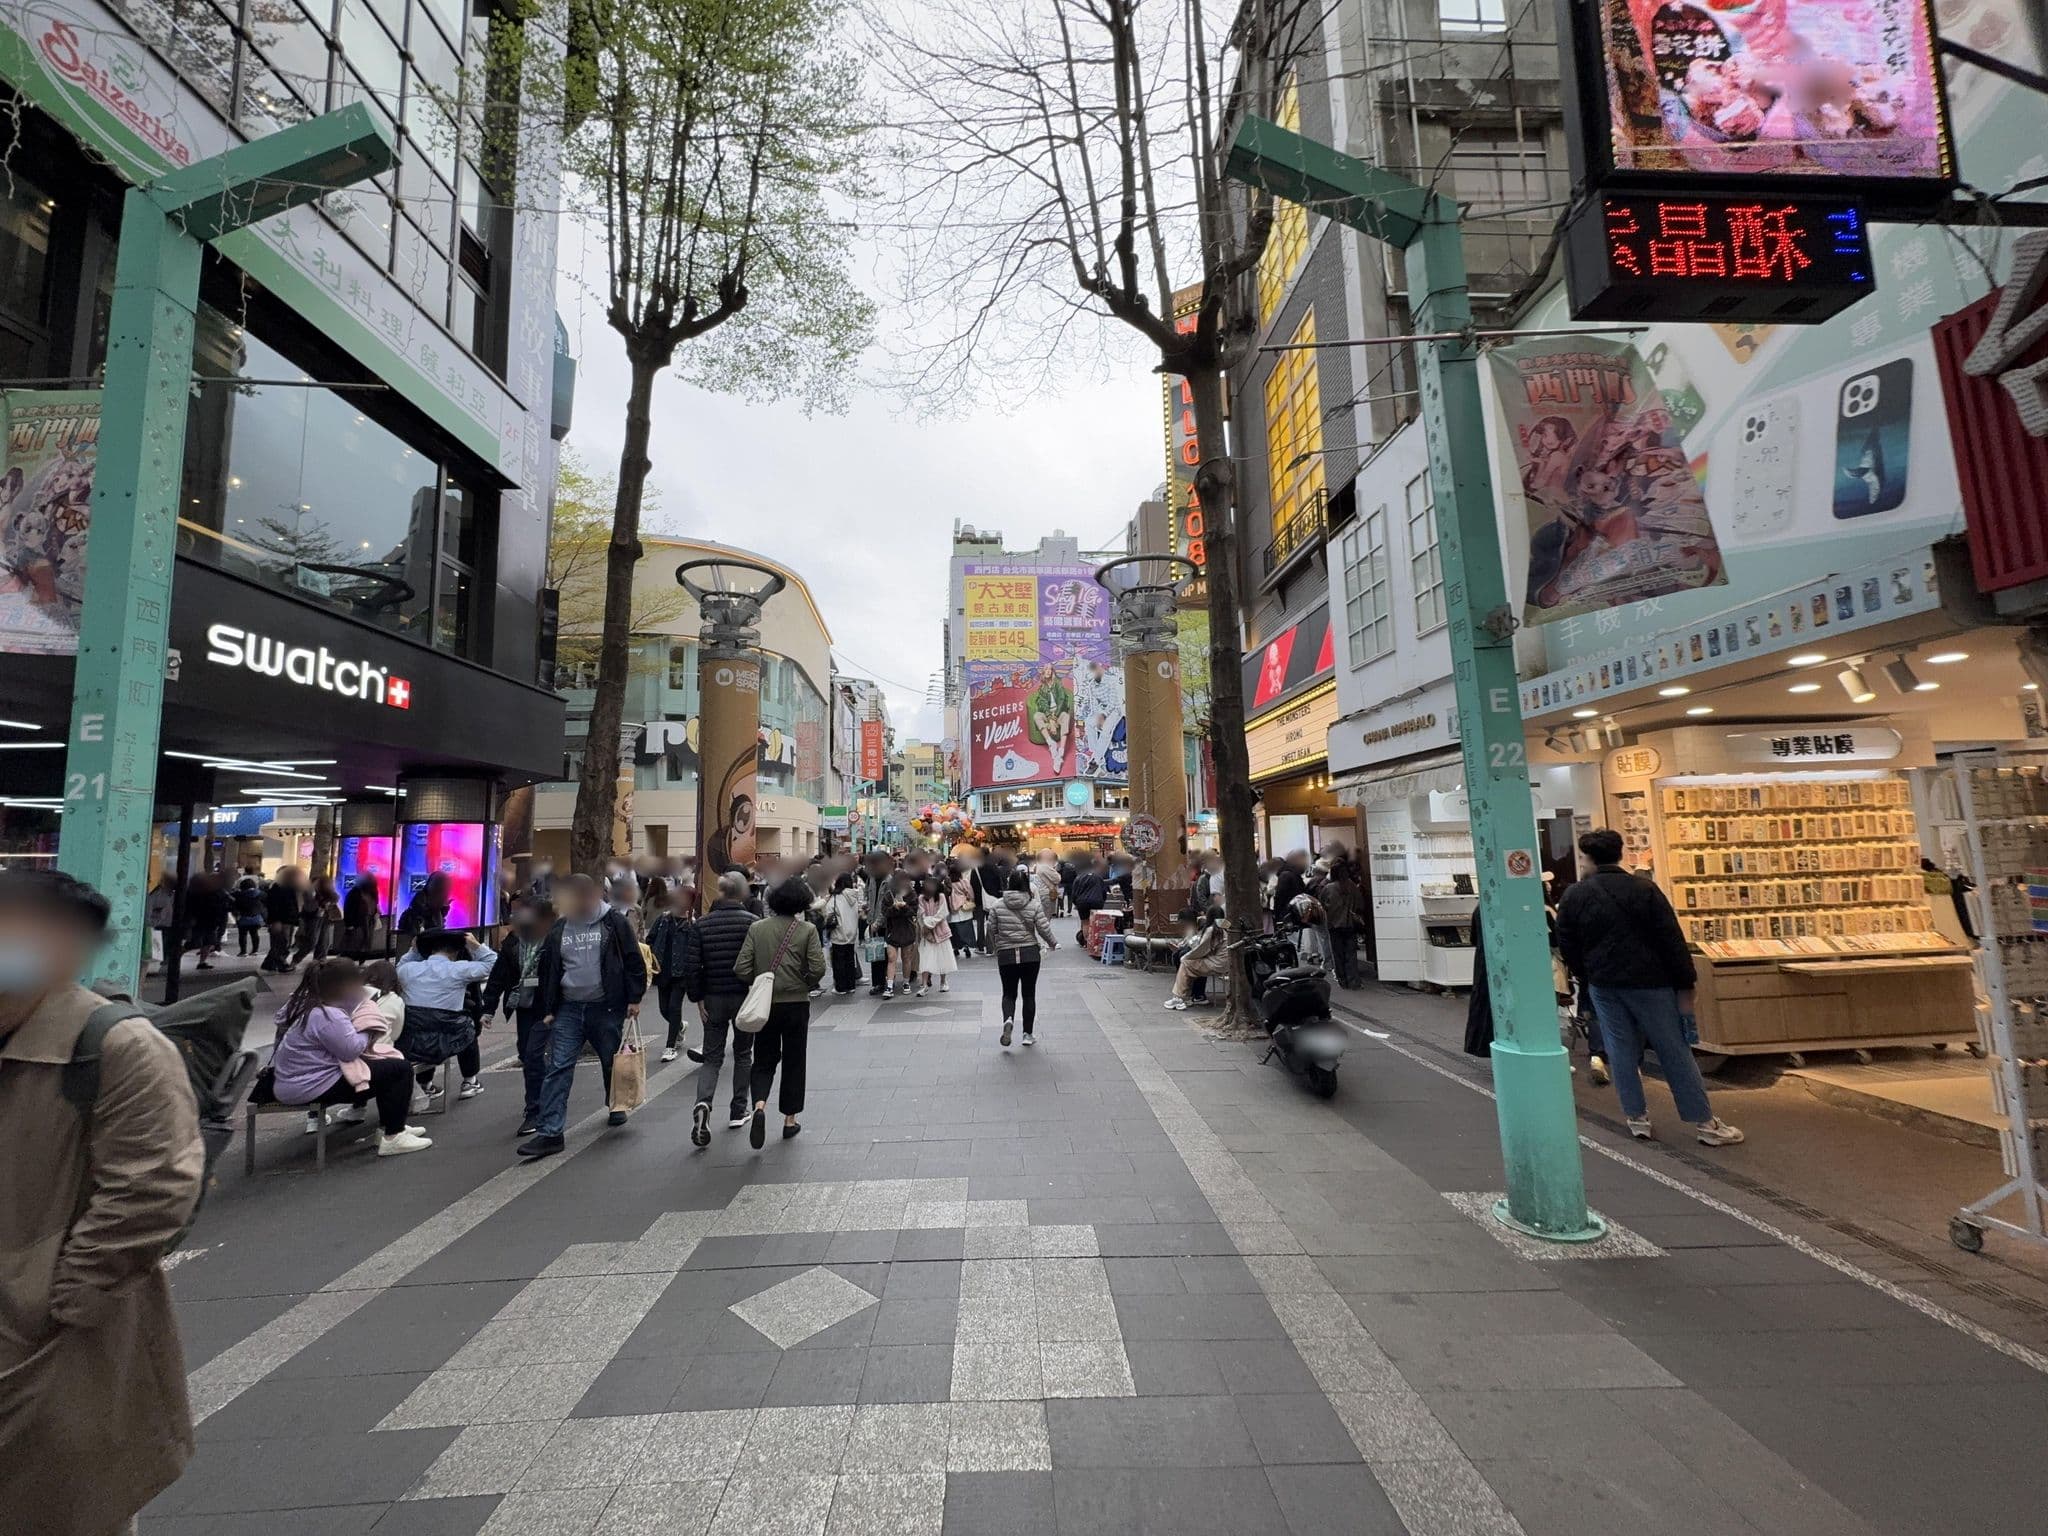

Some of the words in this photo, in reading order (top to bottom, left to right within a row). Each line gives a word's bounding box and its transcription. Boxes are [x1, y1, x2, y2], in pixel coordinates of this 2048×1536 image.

[37, 19, 190, 166] Saizeriya
[1174, 313, 1201, 466] HLLO
[504, 420, 521, 442] 2F
[1084, 618, 1106, 628] KTV
[999, 631, 1025, 646] 549
[207, 623, 385, 704] swatch
[973, 701, 1025, 721] SKECHERS
[1489, 687, 1512, 713] E
[80, 713, 105, 742] E
[1488, 742, 1525, 768] 22
[1771, 733, 1855, 758] 專業貼膜
[1616, 751, 1651, 775] 貼膜
[67, 773, 106, 800] 21
